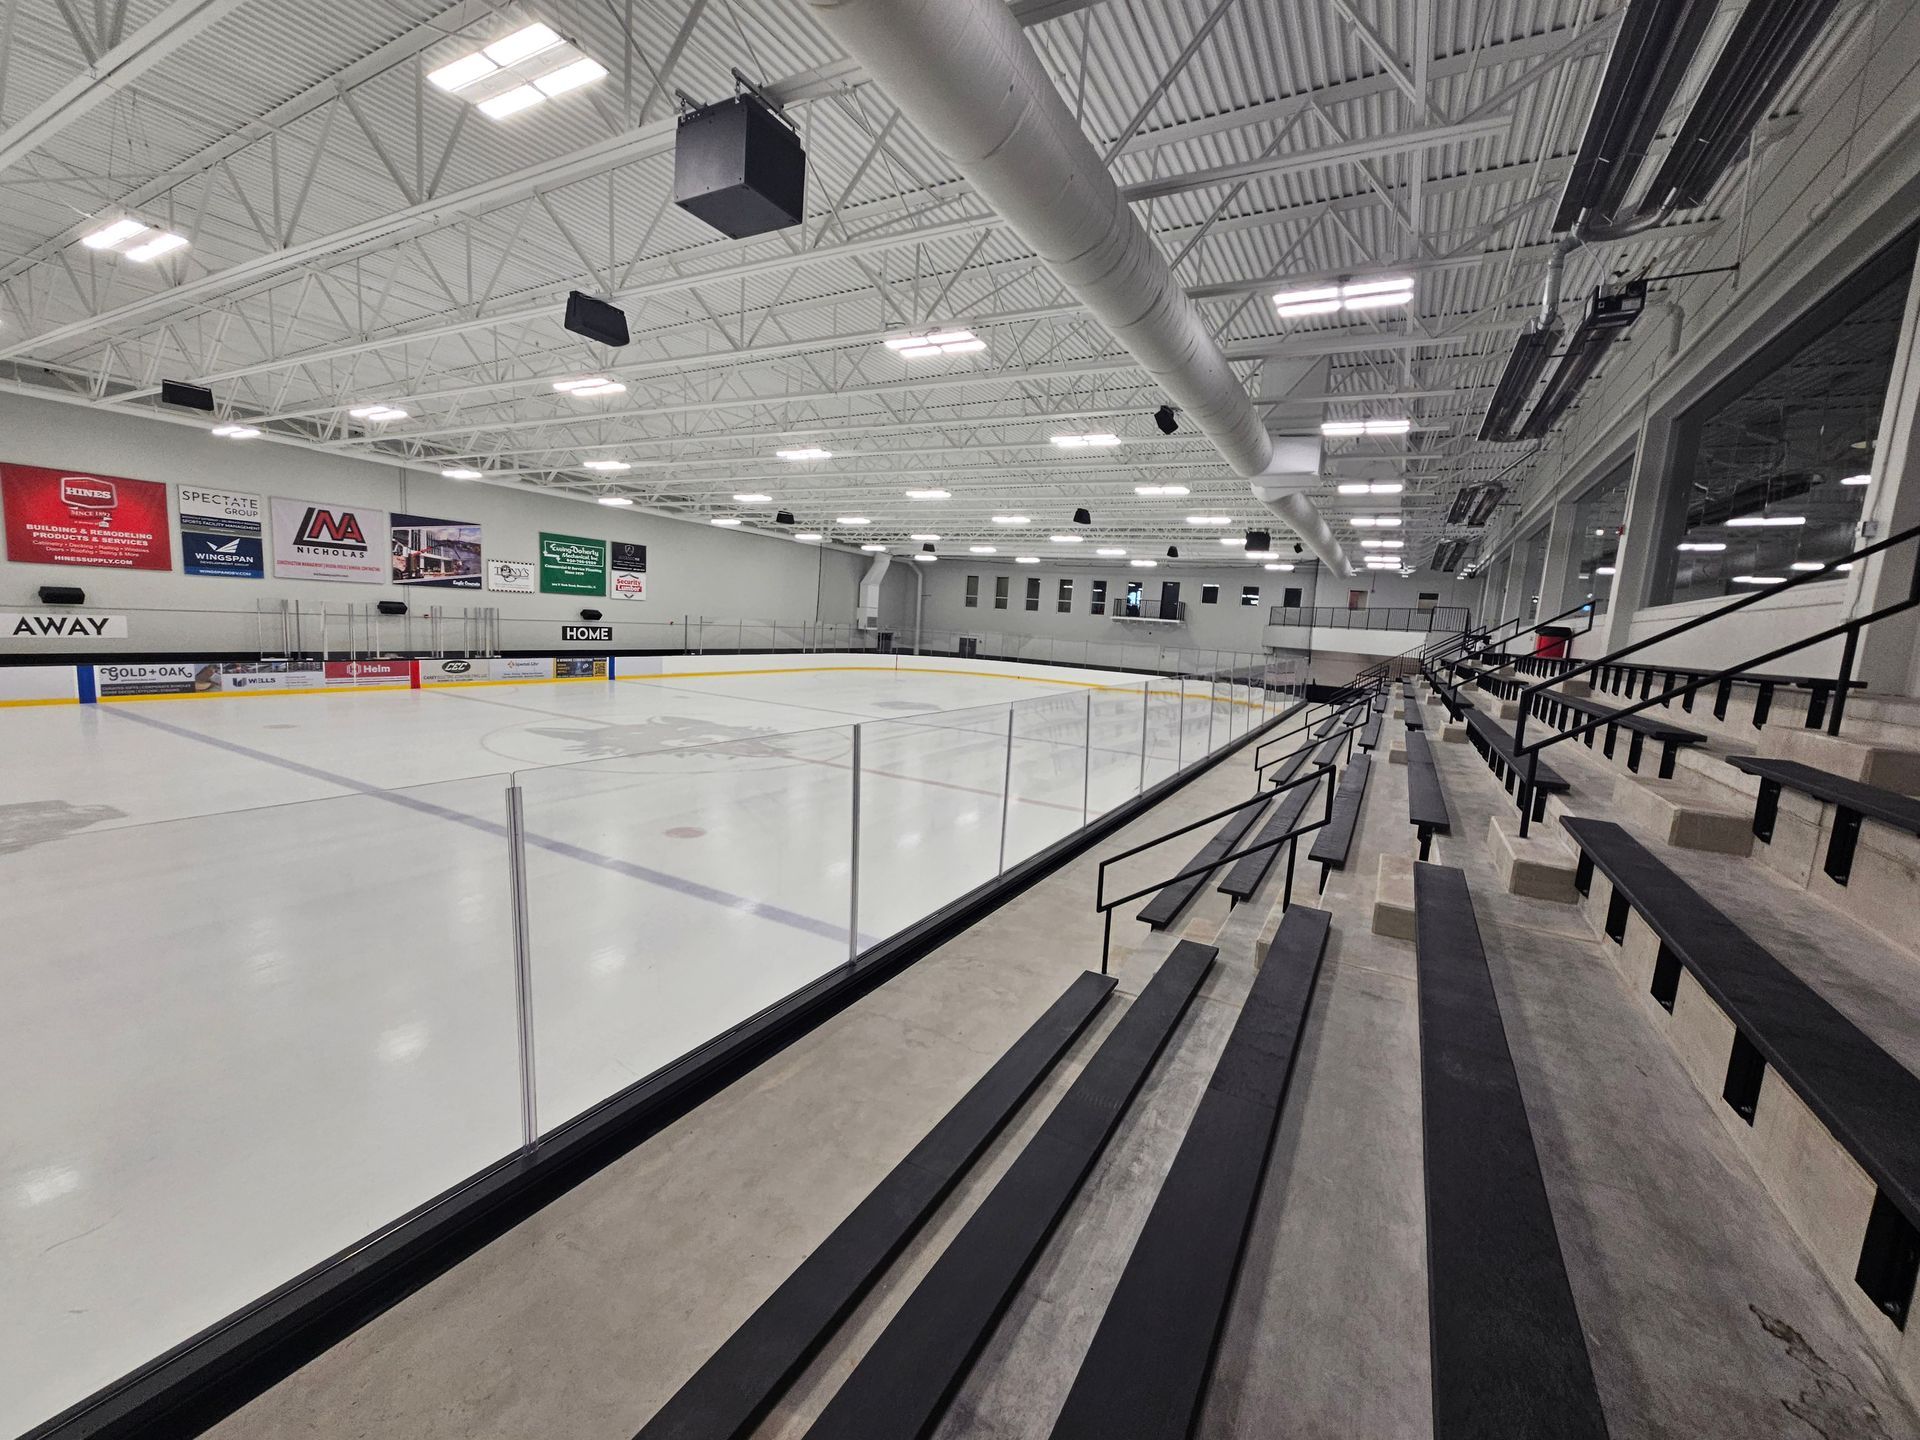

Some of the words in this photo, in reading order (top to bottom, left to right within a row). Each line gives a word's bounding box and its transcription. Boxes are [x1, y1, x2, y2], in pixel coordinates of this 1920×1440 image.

[66, 487, 111, 499] HINES
[182, 490, 258, 509] SPECTATE
[224, 508, 258, 517] GROUP
[203, 520, 225, 528] FACILITY
[225, 523, 261, 531] MANAGEMENT
[26, 524, 77, 534] BUILDING
[90, 530, 153, 540] REMODELING
[33, 532, 89, 542] PRODUCTS
[102, 537, 148, 546] SERVICES
[33, 540, 64, 548] Cabinetry
[70, 542, 94, 550] Decking
[195, 552, 254, 563] WINGSPAN
[297, 547, 365, 559] NICHOLAS
[54, 555, 133, 565] HINESSUPPLY.COM
[13, 616, 110, 636] AWAY
[567, 627, 609, 640] HOME
[363, 664, 391, 674] Helm
[445, 663, 468, 671] CEC
[100, 667, 147, 681] GOLD
[159, 667, 193, 678] OAK
